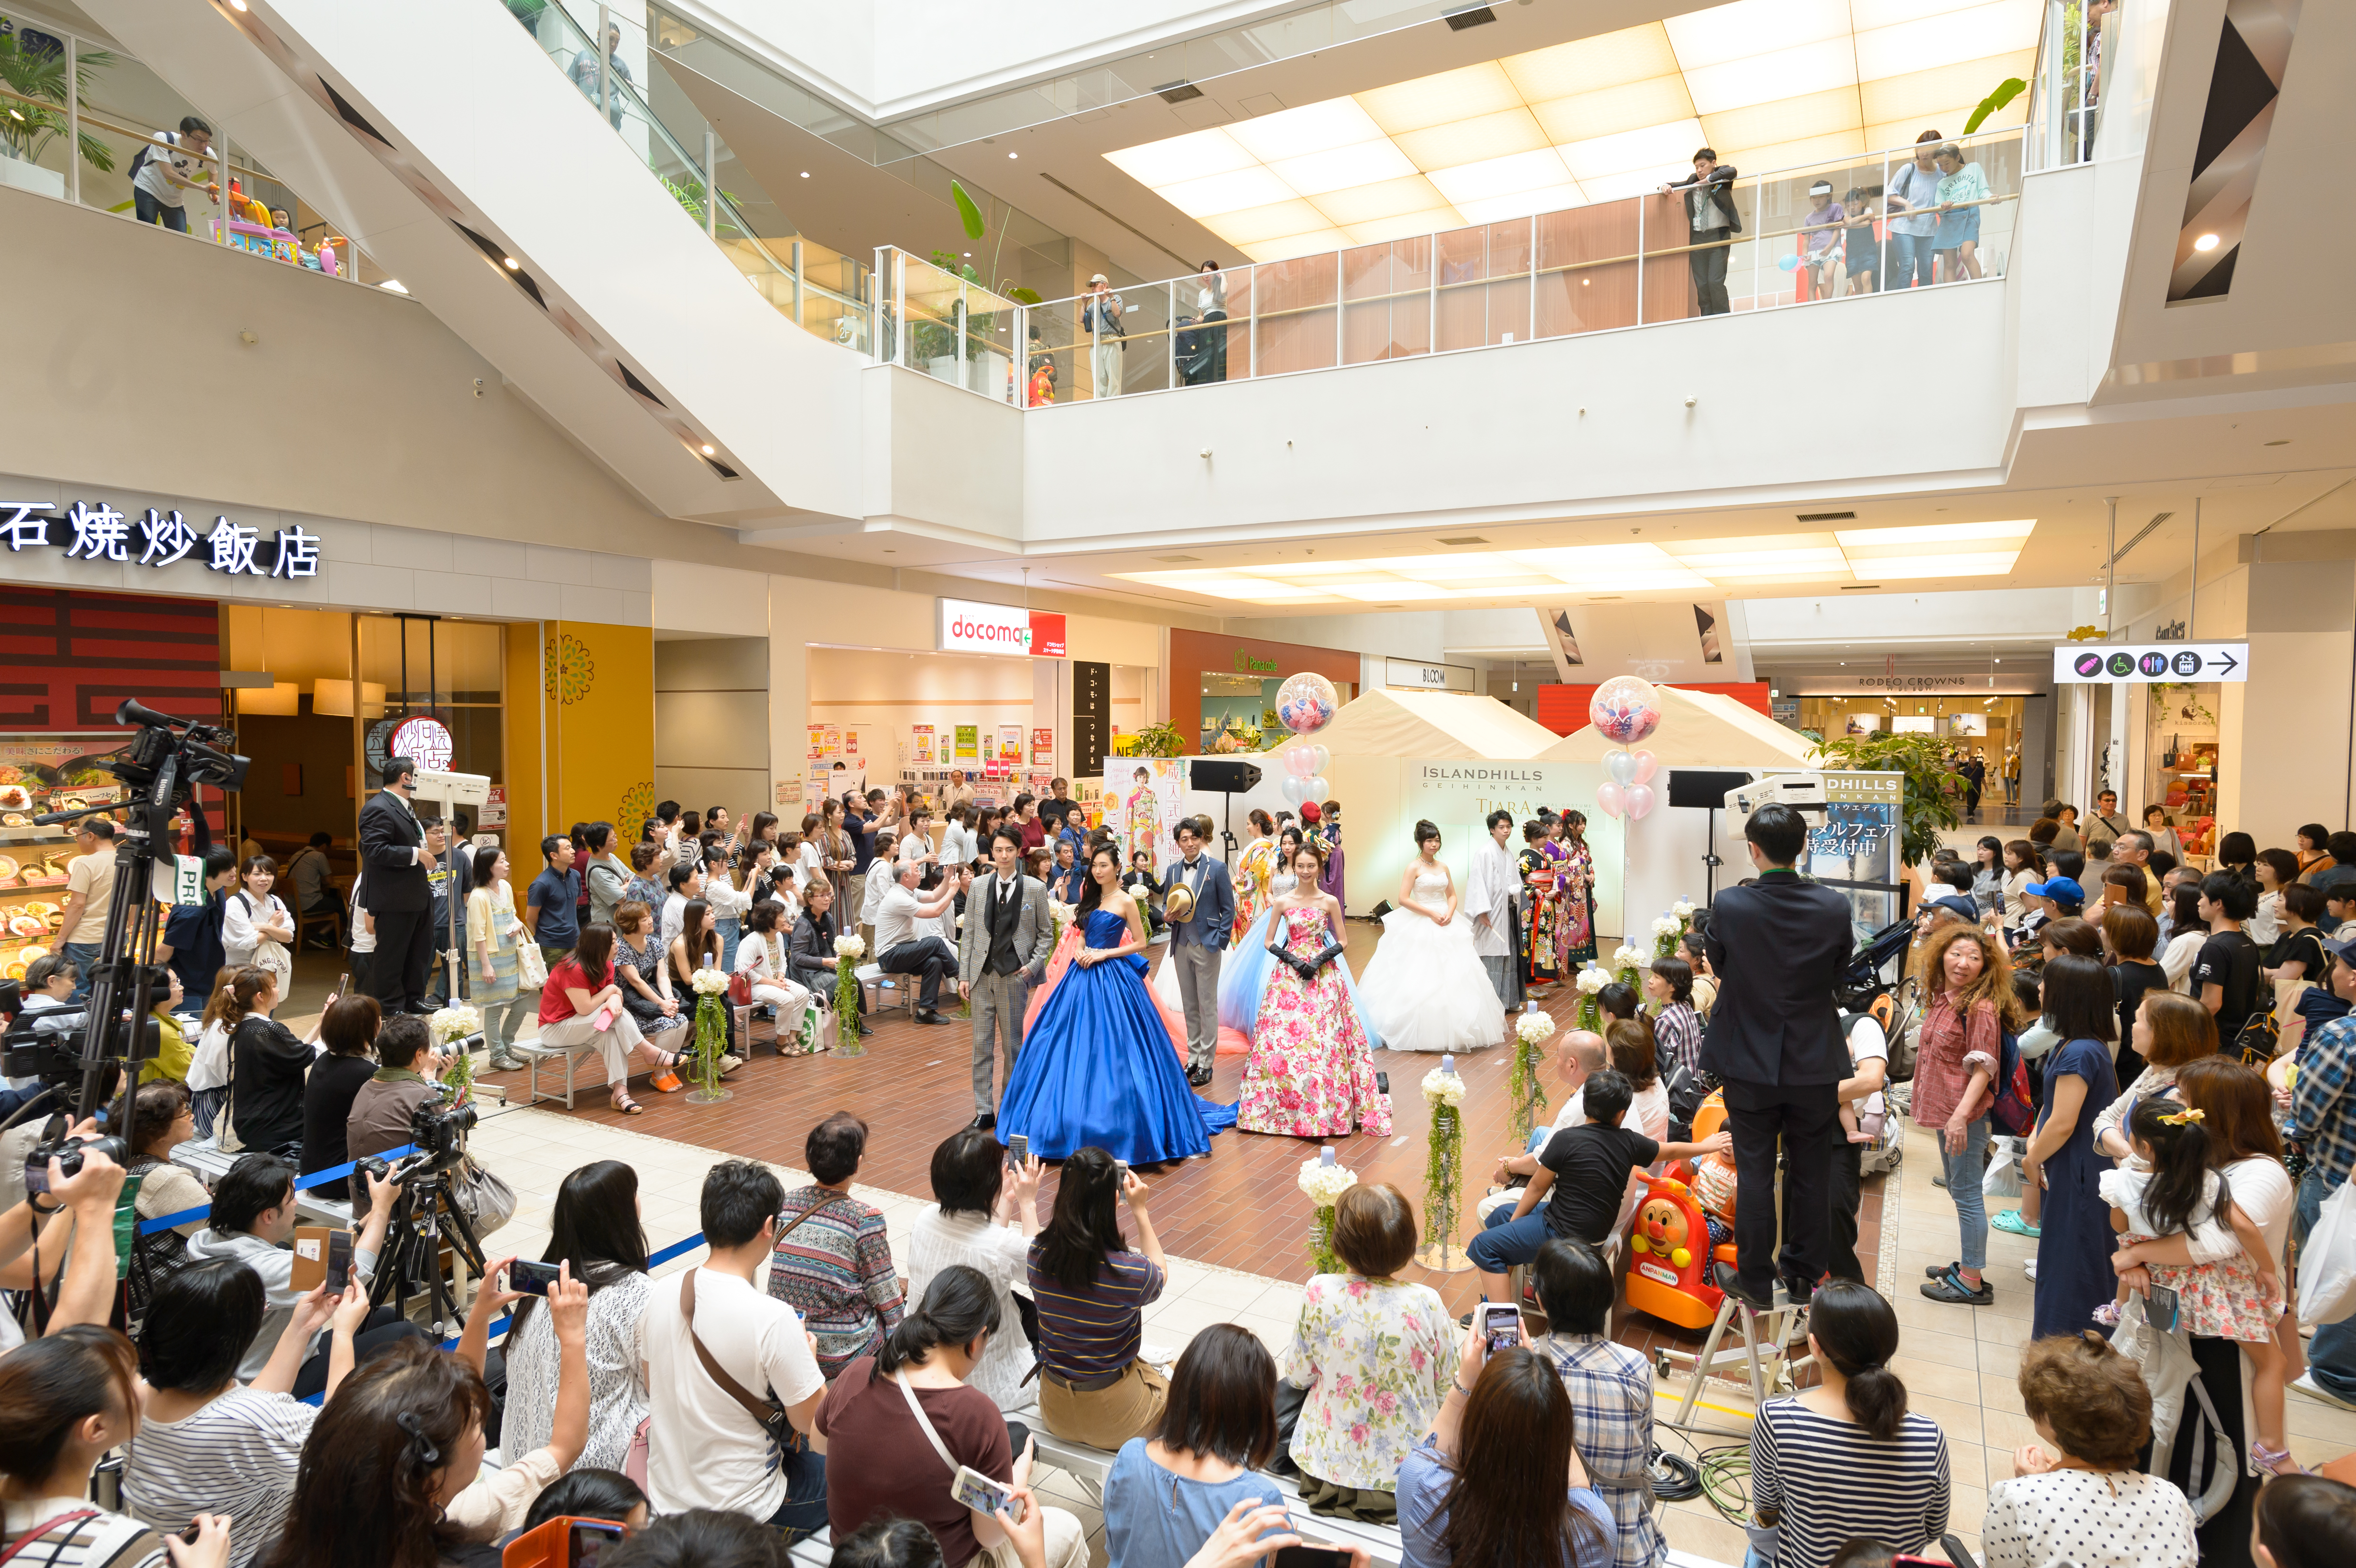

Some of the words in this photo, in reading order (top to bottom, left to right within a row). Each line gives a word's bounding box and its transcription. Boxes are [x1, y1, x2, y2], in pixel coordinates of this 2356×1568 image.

[1945, 174, 1977, 196] SPRIGHTLY
[0, 500, 322, 579] 石焼炒飯店
[952, 614, 1019, 642] docomo
[1423, 668, 1445, 684] BLOOM
[1860, 678, 1902, 686] RODEO
[1908, 677, 1965, 686] CROWNS
[5, 747, 84, 755] 美味さにこだわる!
[1108, 765, 1130, 775] Coming
[1423, 766, 1542, 781] ISLANDHILLS
[154, 778, 168, 806] Canon
[1423, 782, 1542, 792] GEIHINKAN
[1476, 798, 1532, 815] TIARA
[1703, 1160, 1735, 1182] ALOHA
[1641, 1265, 1677, 1282] ANPANMAN
